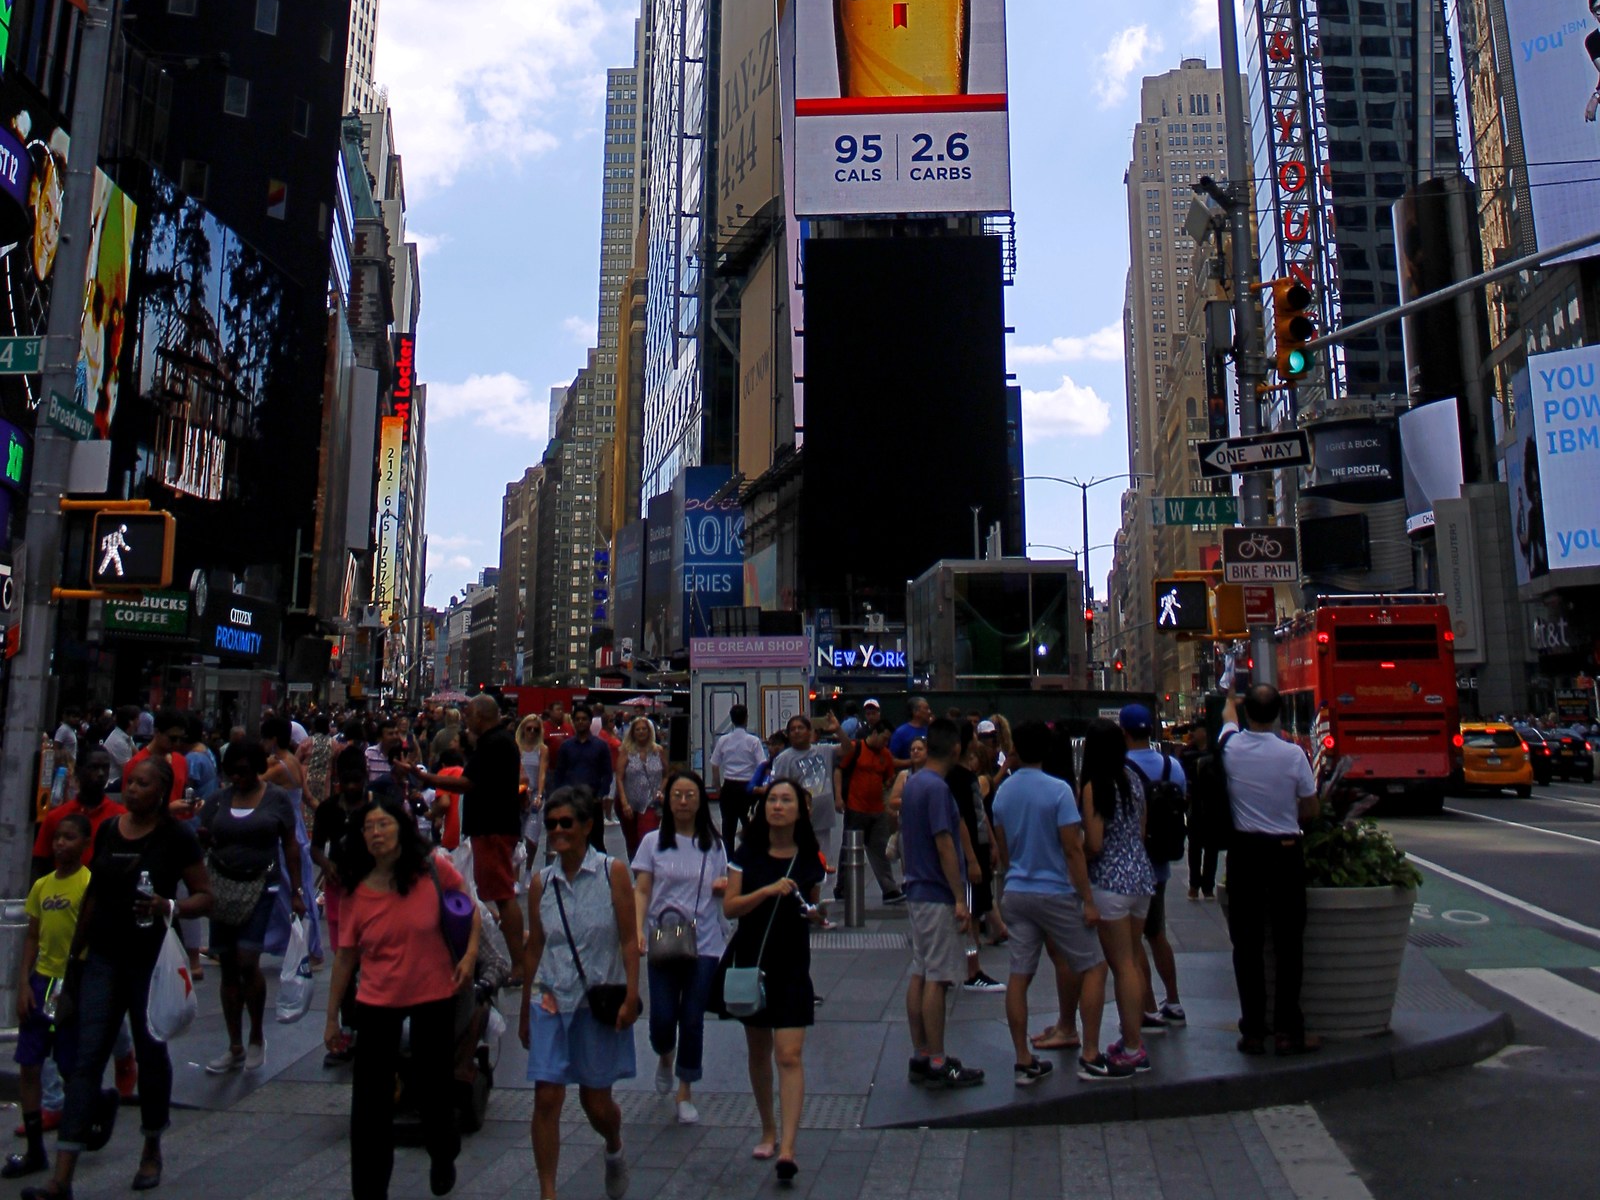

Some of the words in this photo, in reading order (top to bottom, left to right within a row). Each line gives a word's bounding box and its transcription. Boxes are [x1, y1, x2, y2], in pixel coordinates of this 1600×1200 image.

[1268, 31, 1292, 61] &
[1521, 31, 1563, 62] you
[1562, 18, 1587, 36] IBM
[720, 111, 758, 200] 4:44
[834, 134, 883, 164] 95
[911, 132, 970, 162] 2.6
[9, 153, 19, 184] 12
[834, 169, 882, 182] CALS
[910, 166, 972, 181] CARBS
[25, 341, 39, 356] ST
[393, 337, 413, 398] Locker
[1540, 362, 1595, 392] YOU
[49, 394, 93, 440] Broadway
[1216, 448, 1247, 464] ONE
[1261, 443, 1293, 458] WAY
[1330, 442, 1346, 451] GIVE
[1348, 441, 1354, 449] A
[1547, 425, 1600, 455] IBM
[1331, 467, 1346, 477] THE
[1347, 464, 1380, 476] PROFIT
[1169, 501, 1185, 521] W
[1195, 500, 1217, 520] 44
[1451, 522, 1460, 565] REUTERS
[1232, 565, 1259, 579] BIKE
[1264, 564, 1292, 578] PATH
[1453, 567, 1463, 615] THOMSON
[115, 609, 168, 625] COFFEE
[230, 608, 253, 626] CITIZEN
[215, 624, 263, 655] PROXIMITY
[693, 641, 715, 652] ICE
[718, 641, 764, 652] CREAM
[768, 640, 803, 652] SHOP
